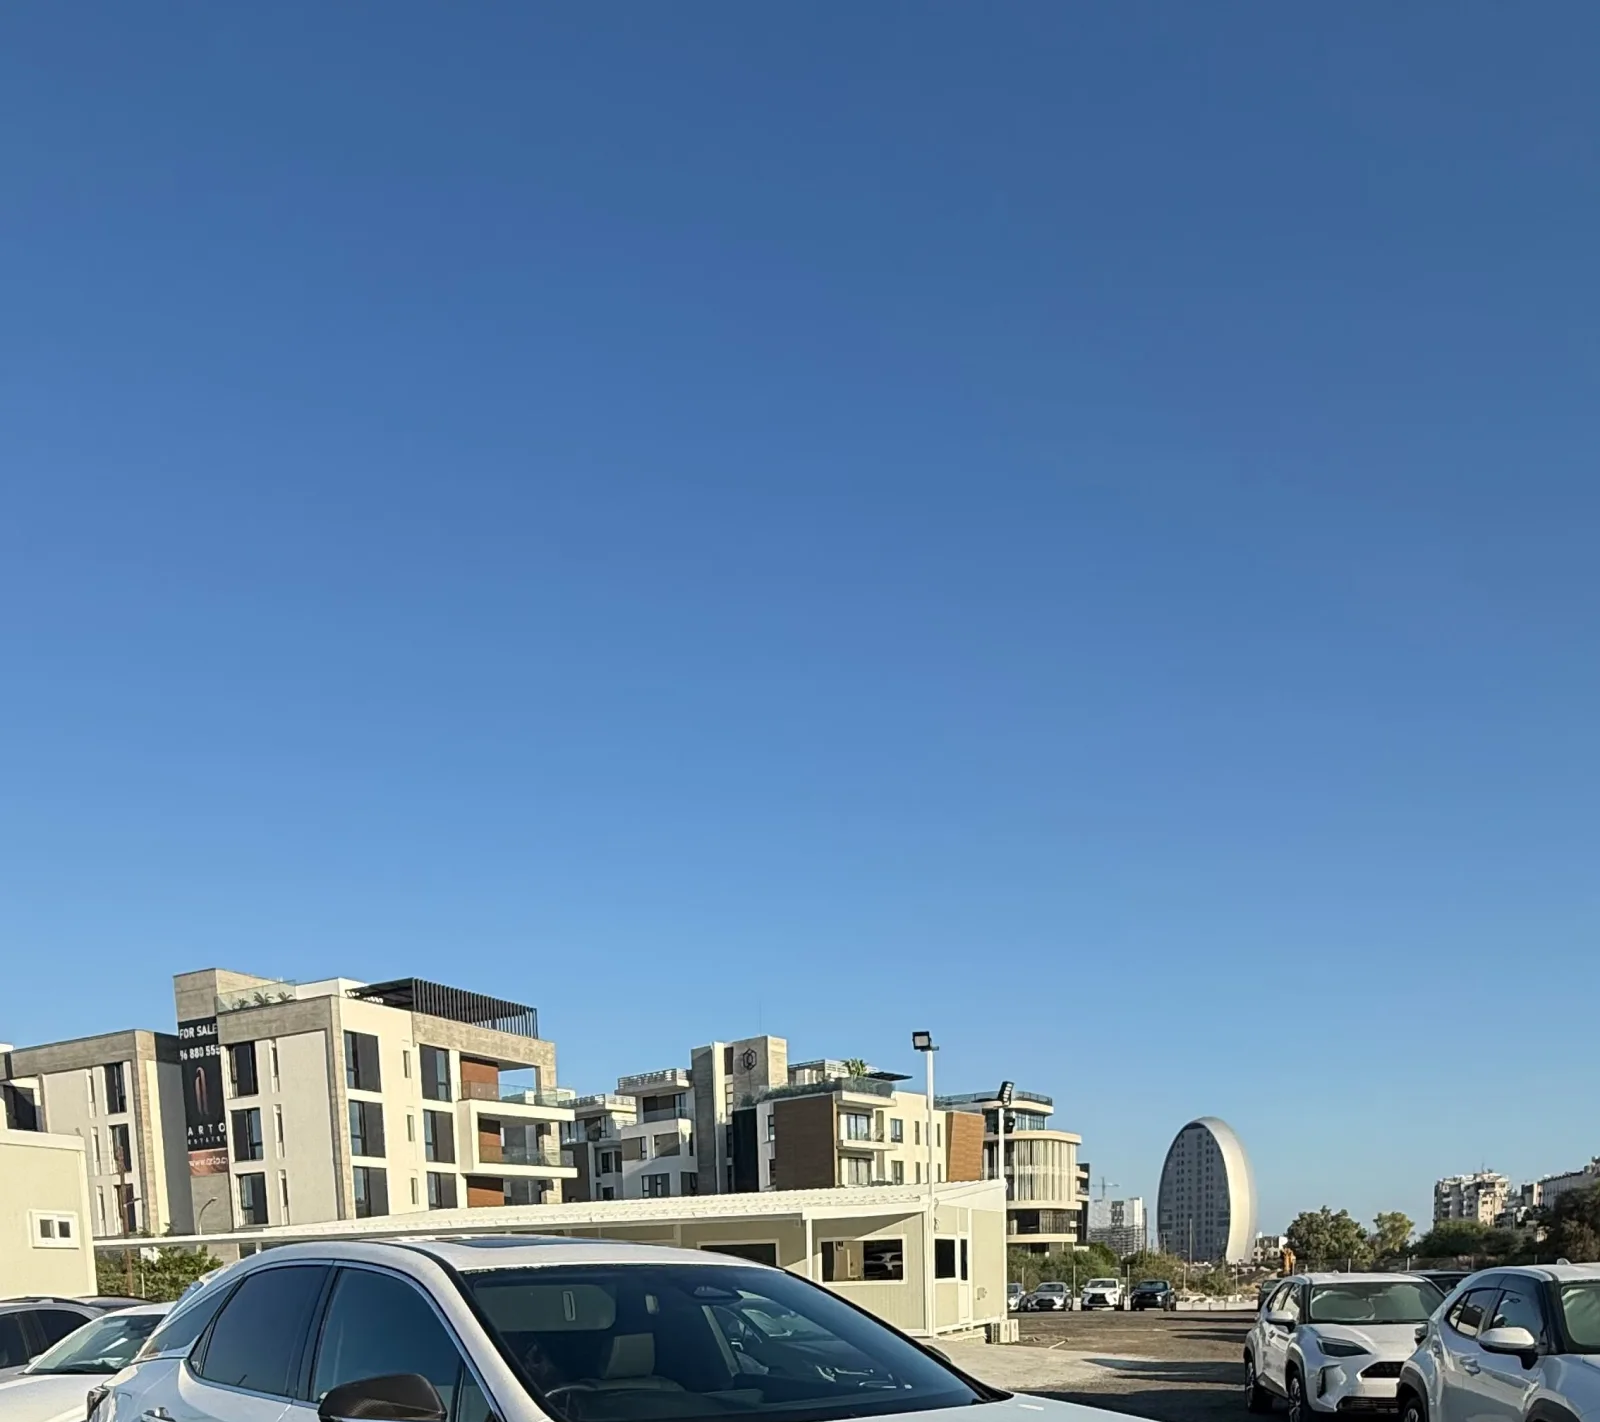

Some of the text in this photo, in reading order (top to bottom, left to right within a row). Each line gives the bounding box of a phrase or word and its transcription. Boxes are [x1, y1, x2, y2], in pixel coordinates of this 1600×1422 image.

[179, 1023, 218, 1040] FOR SALE
[189, 1046, 205, 1059] 880
[187, 1122, 226, 1137] ARTO
